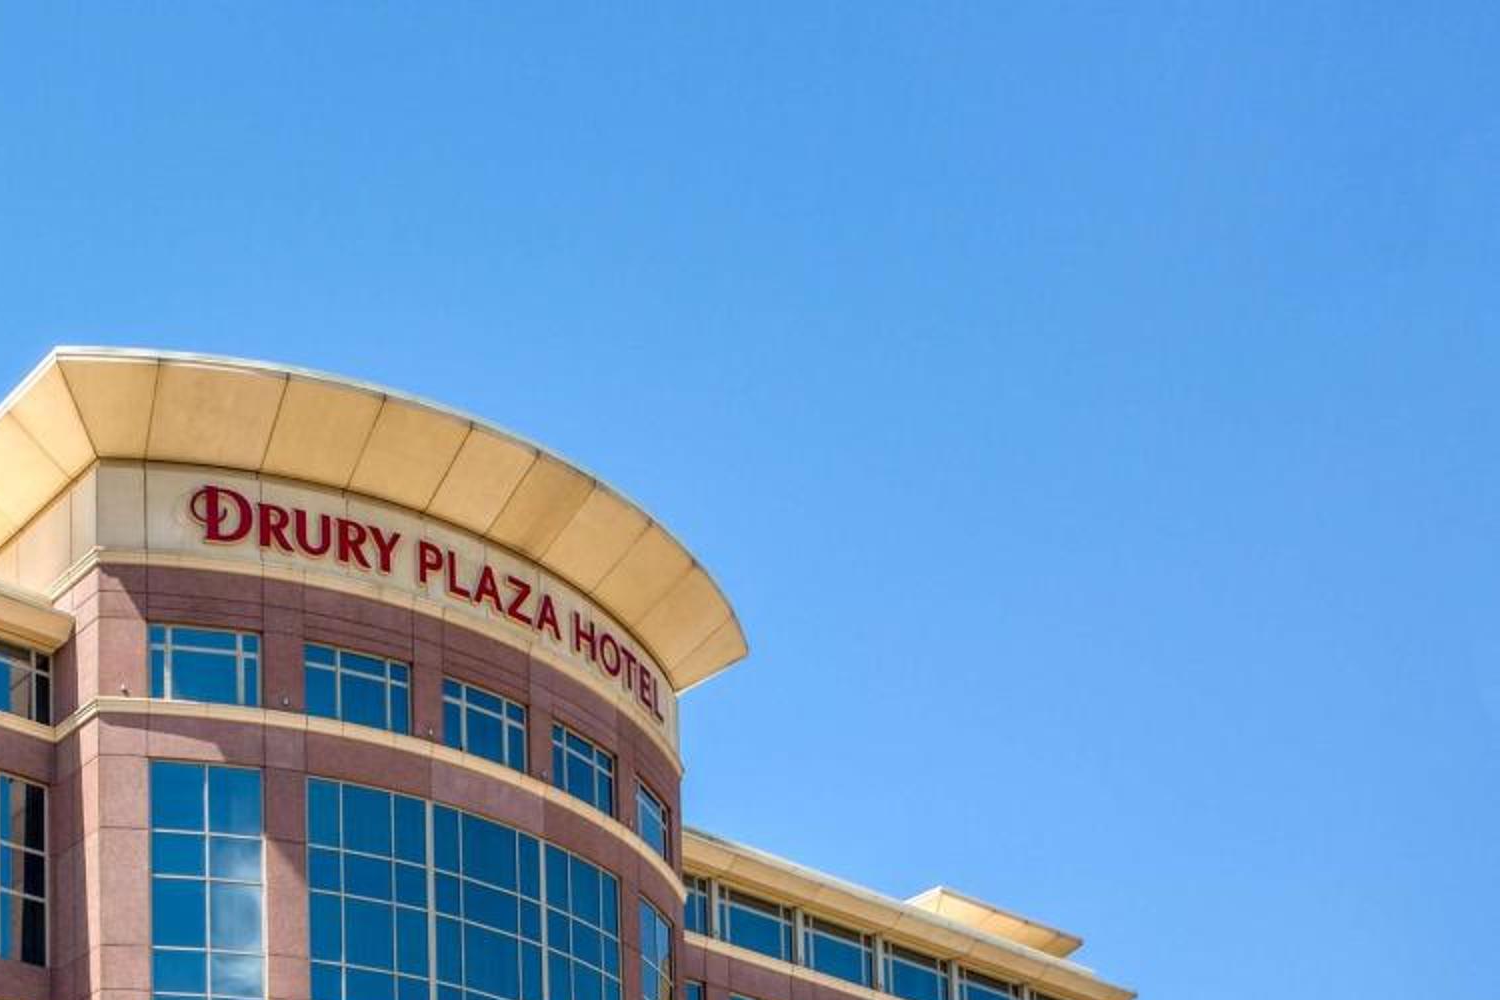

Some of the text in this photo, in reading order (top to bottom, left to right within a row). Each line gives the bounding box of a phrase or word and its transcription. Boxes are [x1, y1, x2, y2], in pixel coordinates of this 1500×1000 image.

[190, 485, 665, 723] DRURY PLAZA HOTEL
